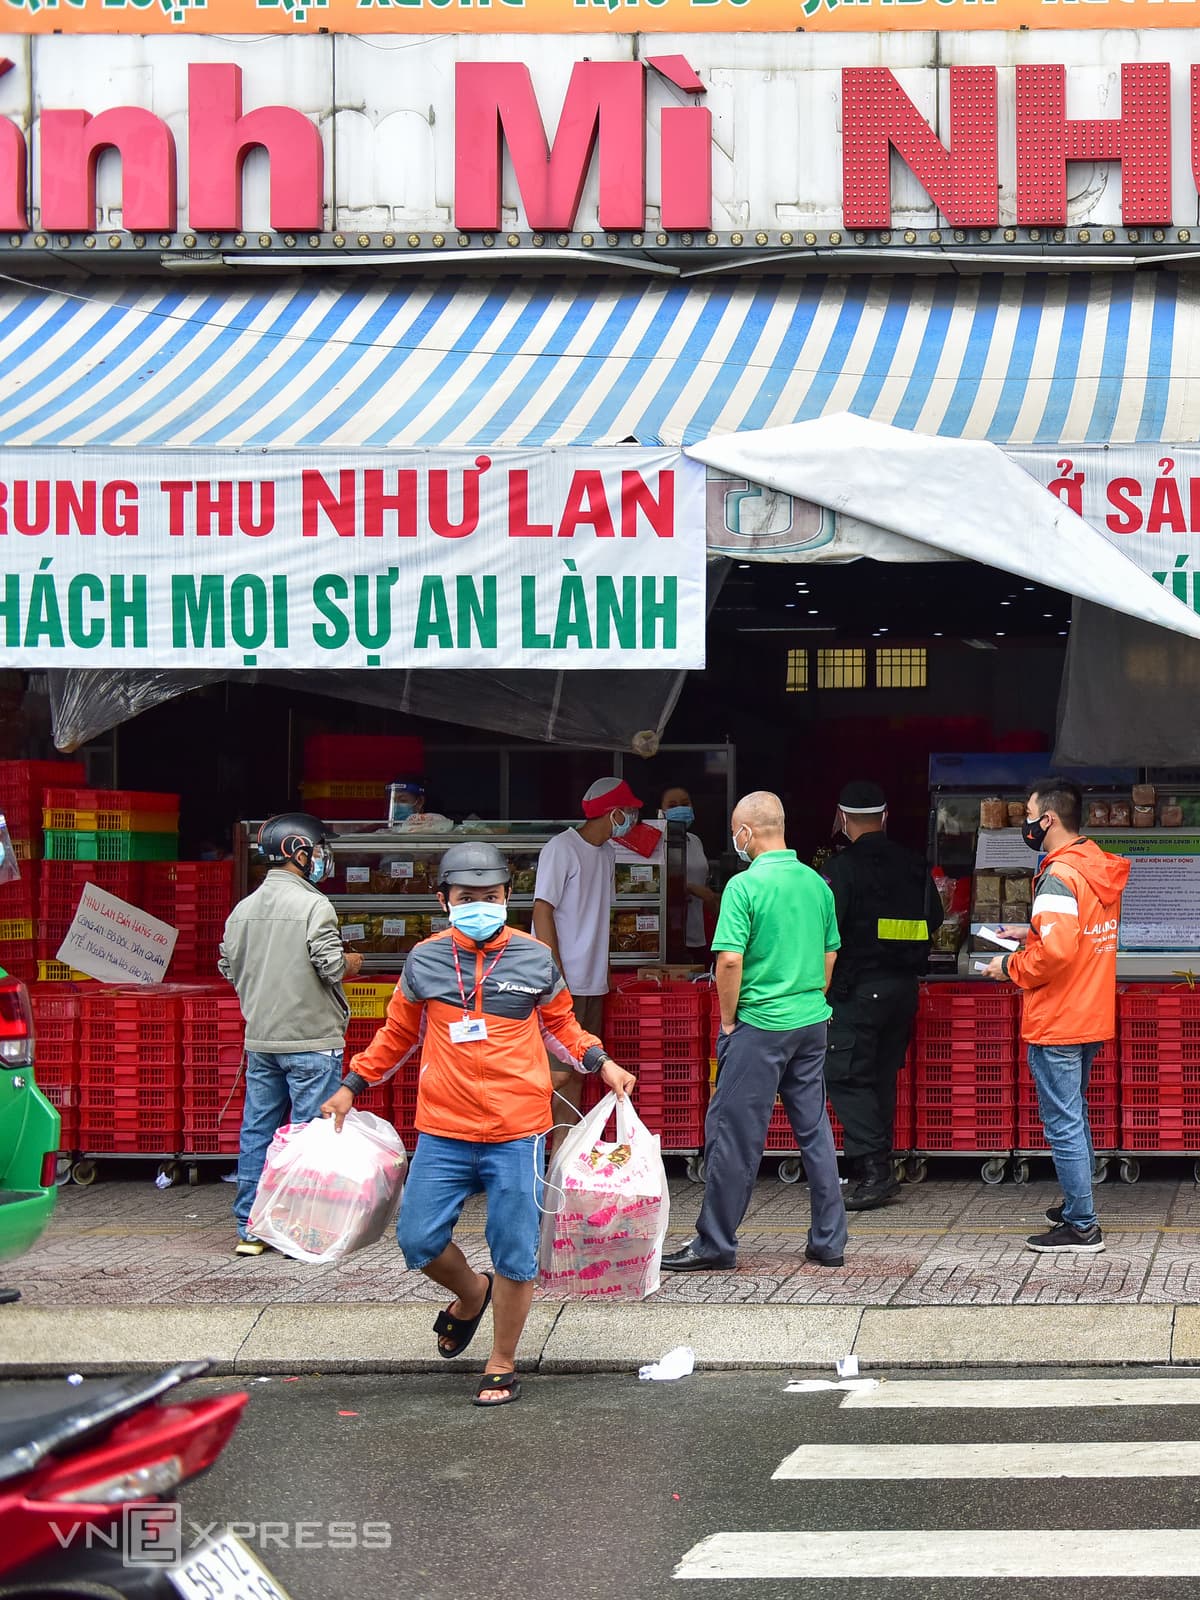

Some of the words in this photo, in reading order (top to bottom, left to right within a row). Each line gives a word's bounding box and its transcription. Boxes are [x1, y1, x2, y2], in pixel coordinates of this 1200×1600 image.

[0, 57, 325, 232] nh
[455, 55, 712, 231] Mì
[0, 480, 139, 537] UNG
[161, 481, 275, 537] THU
[302, 455, 492, 538] NHƯ
[508, 469, 675, 538] LAN
[172, 573, 289, 666] MỌI
[312, 567, 399, 666] SỰ
[414, 575, 497, 649] AN
[521, 559, 678, 649] LÀNH
